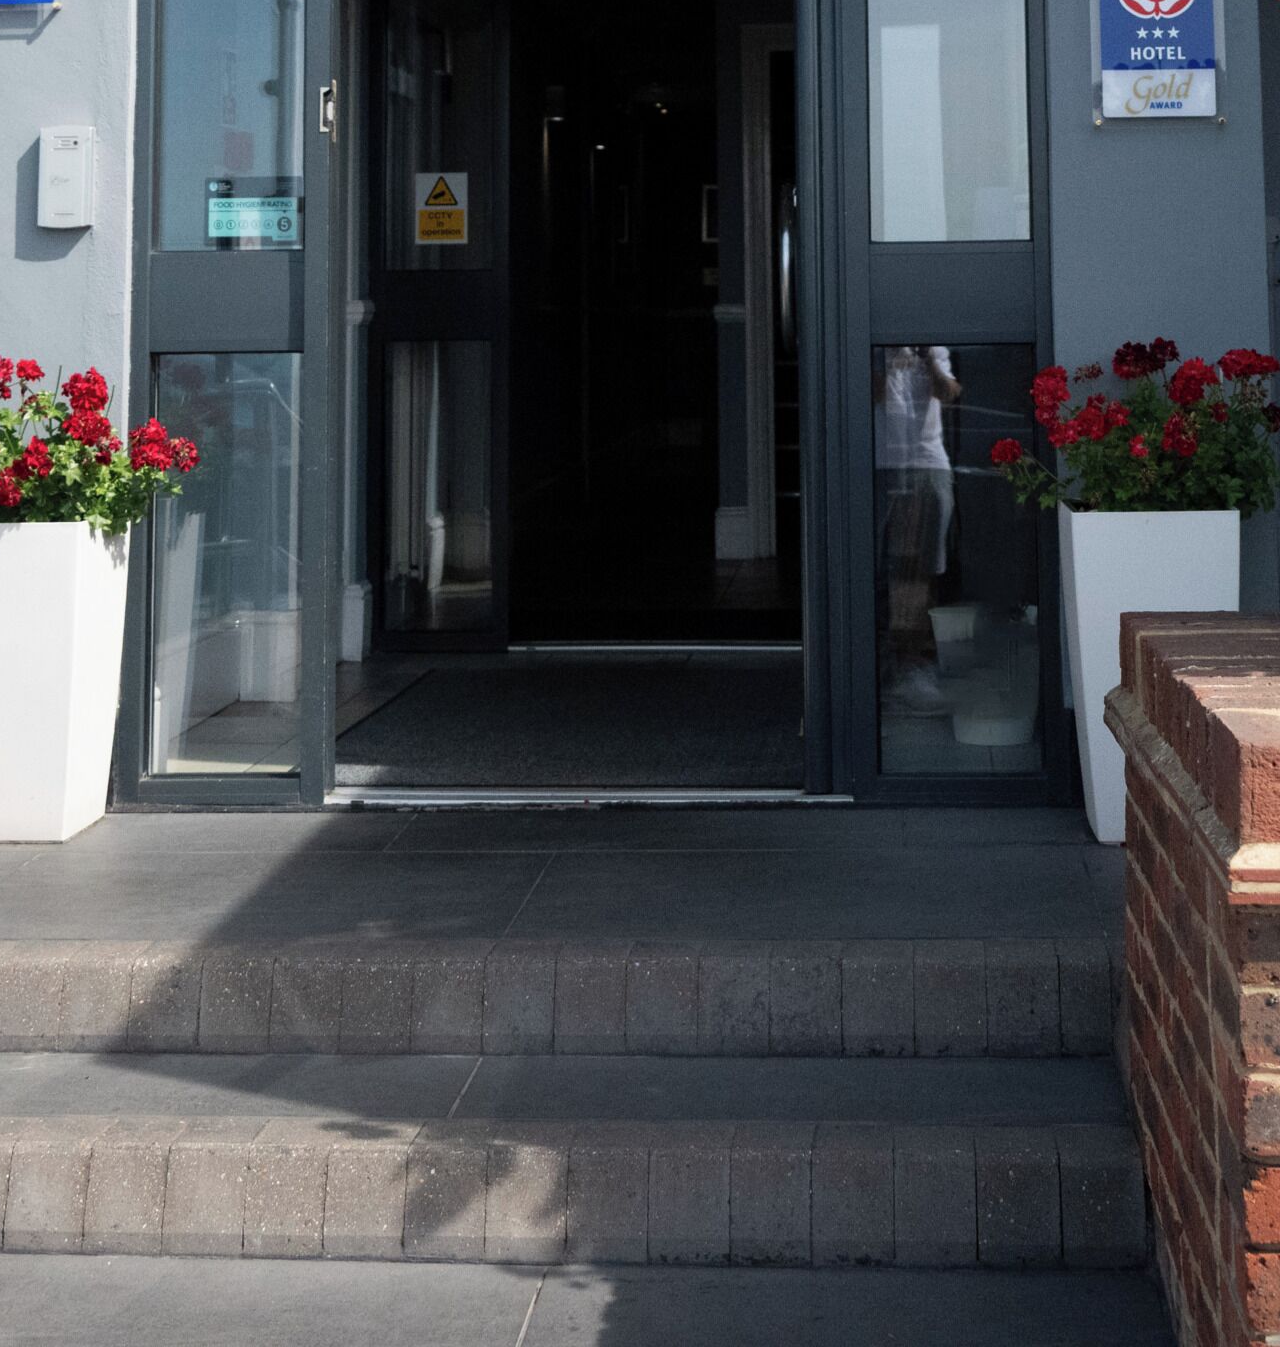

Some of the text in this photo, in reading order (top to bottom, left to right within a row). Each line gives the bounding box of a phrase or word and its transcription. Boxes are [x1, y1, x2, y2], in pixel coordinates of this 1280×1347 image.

[1130, 46, 1186, 61] HOTEL
[1124, 72, 1195, 115] Gold
[280, 218, 289, 230] 5
[422, 228, 461, 236] operation
